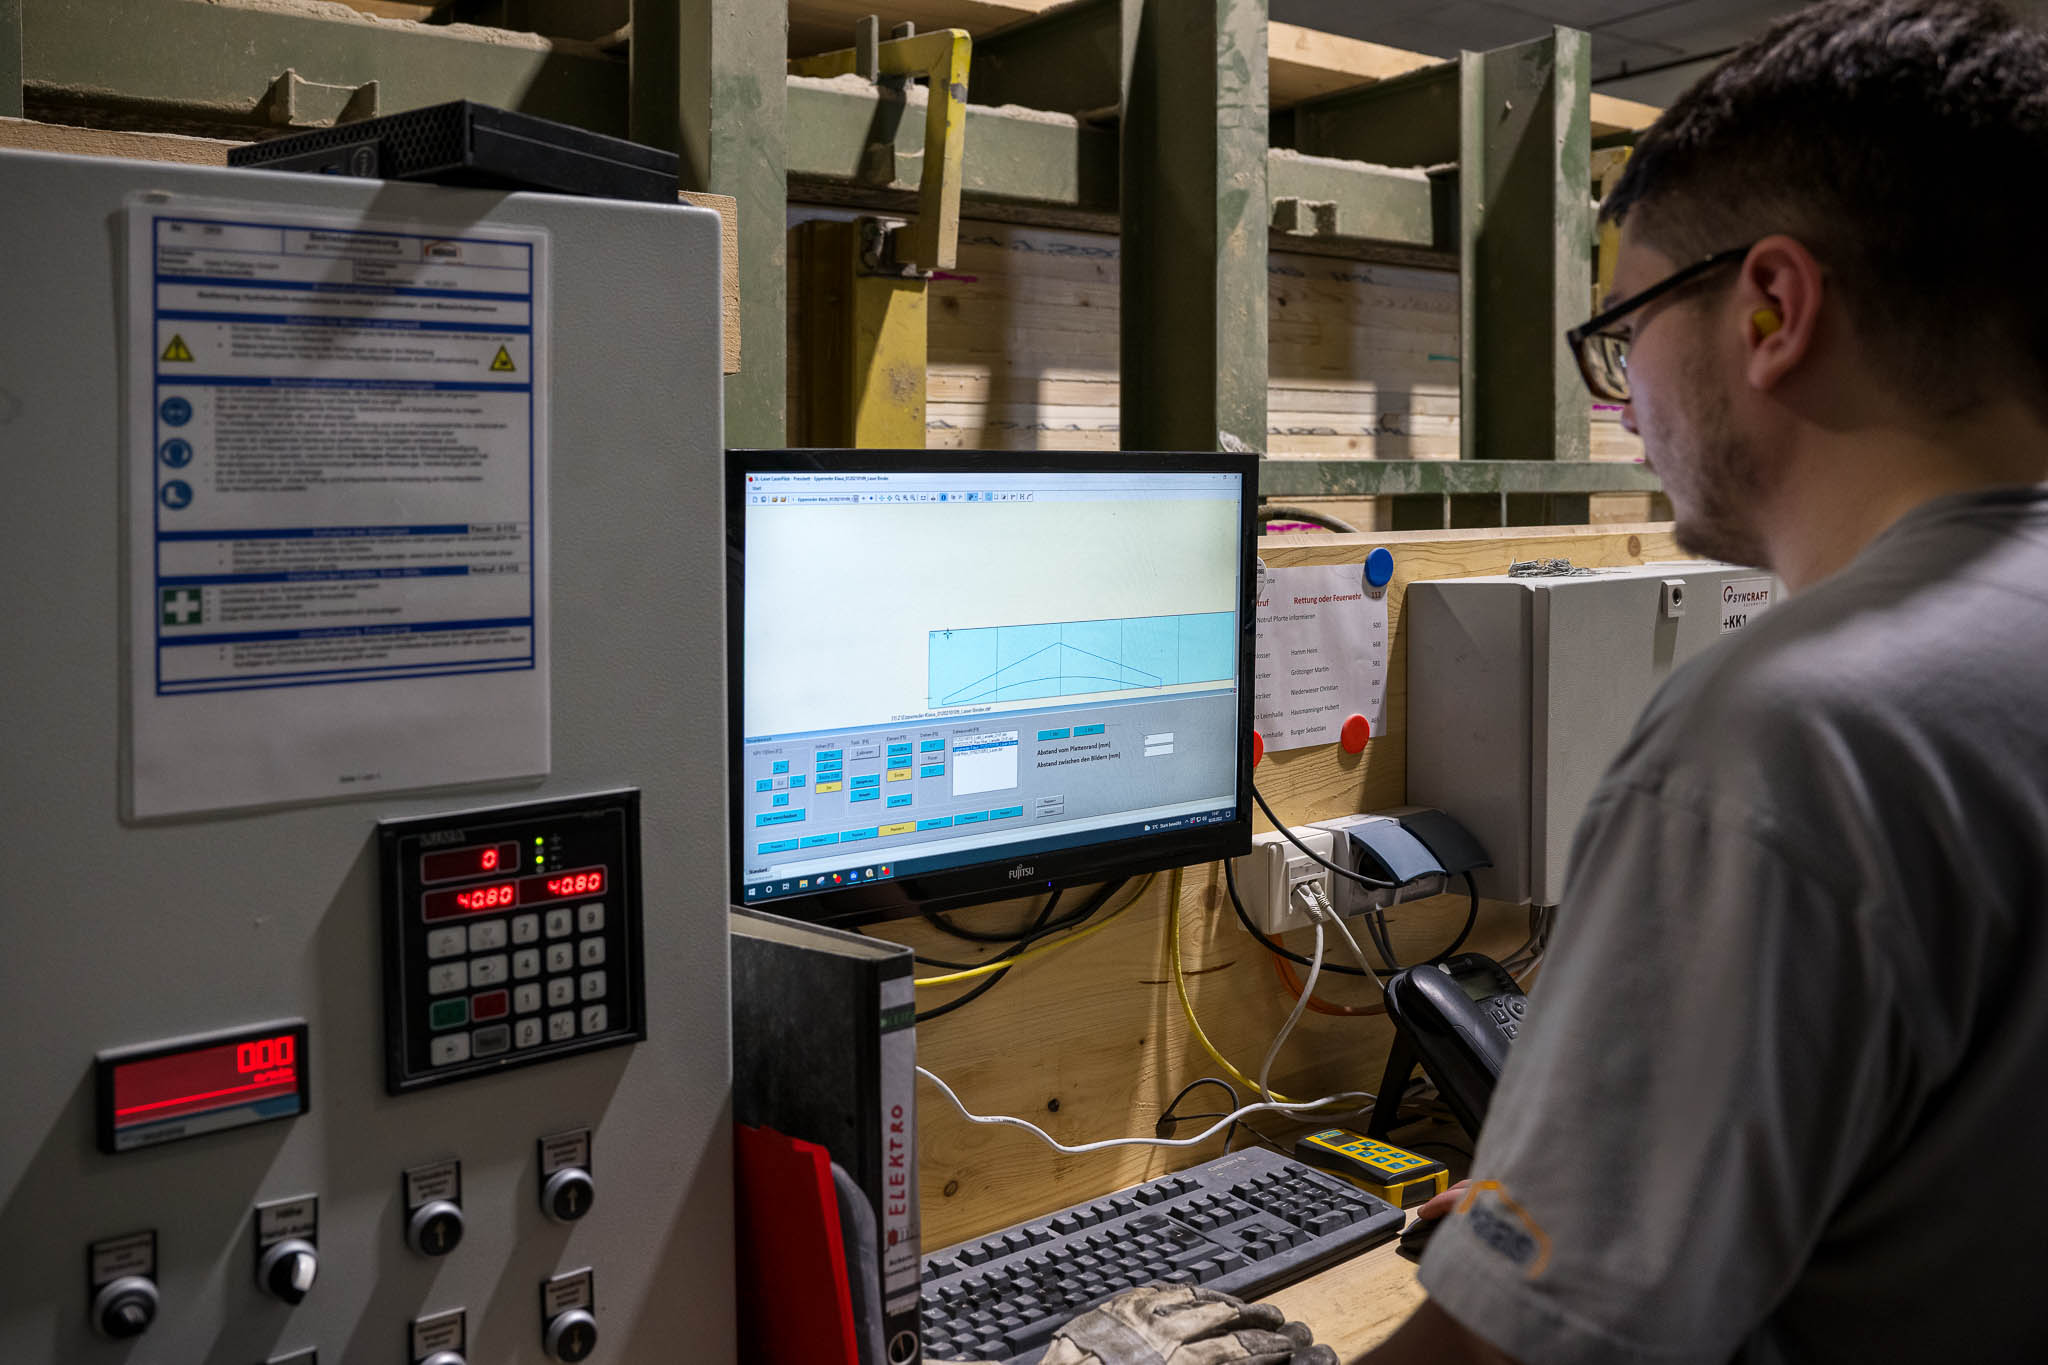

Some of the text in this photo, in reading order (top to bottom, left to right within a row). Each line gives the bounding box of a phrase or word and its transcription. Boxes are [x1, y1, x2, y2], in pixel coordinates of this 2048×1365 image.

[1256, 599, 1269, 607] truf
[1293, 596, 1317, 605] Rettung
[1318, 595, 1332, 603] oder
[1333, 593, 1361, 602] Feuerwehr
[1732, 591, 1768, 603] SYNCRAFT
[1257, 613, 1315, 623] Notruf Pforte informieren
[1723, 614, 1747, 629] +KK1
[1291, 687, 1318, 696] Niederwieser
[1260, 711, 1283, 720] Leimhalle
[1324, 703, 1340, 711] Hubert
[1306, 725, 1326, 733] Sebastian
[1037, 747, 1058, 756] Abstand
[1069, 743, 1098, 752] Plattenrand
[1037, 760, 1058, 768] Abstand
[1058, 757, 1080, 766] zwischen
[1080, 755, 1090, 763] den
[1090, 753, 1108, 762] Bildern
[481, 849, 497, 870] 0
[749, 867, 768, 875] Standard
[1009, 864, 1034, 880] FUJITSU
[888, 1104, 906, 1217] ELEKTRO
